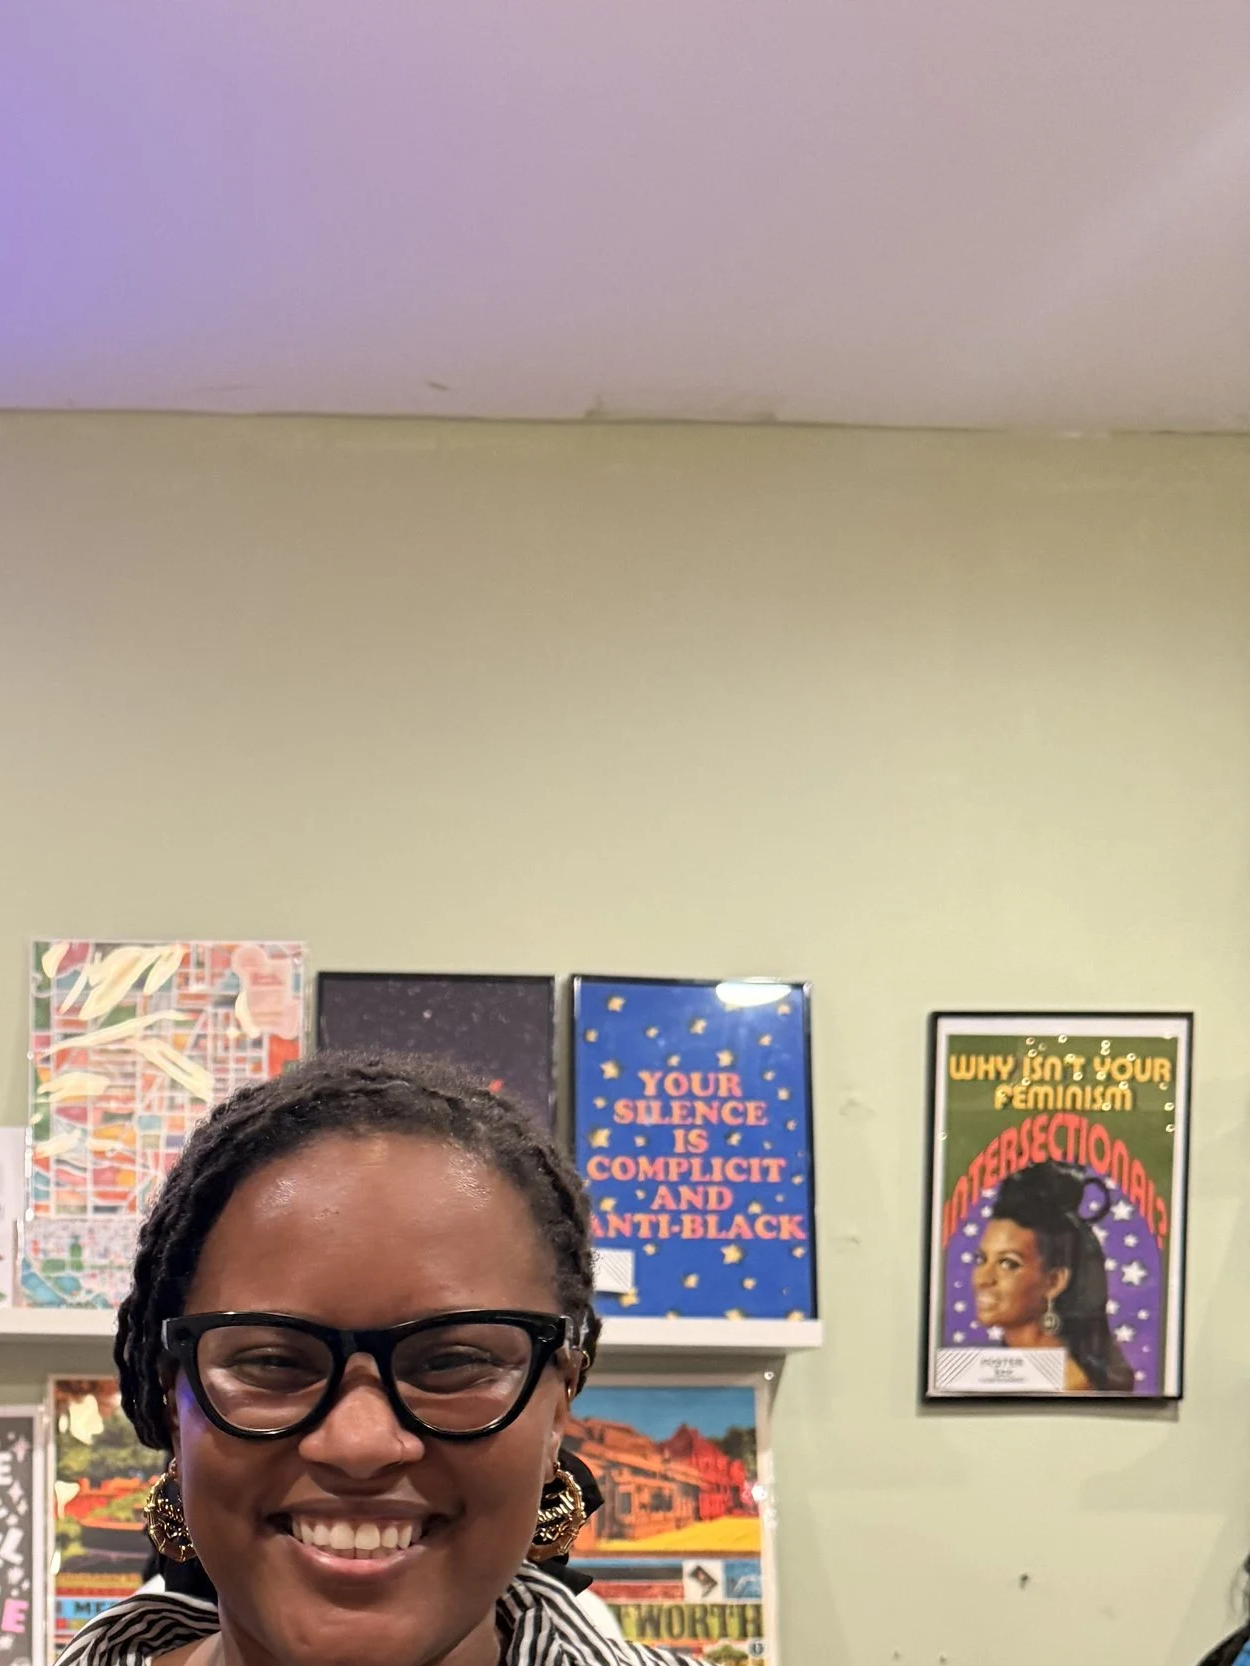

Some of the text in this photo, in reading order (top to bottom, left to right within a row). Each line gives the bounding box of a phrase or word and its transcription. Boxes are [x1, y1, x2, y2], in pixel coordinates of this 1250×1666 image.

[950, 1054, 1014, 1081] WHY
[1093, 1056, 1172, 1083] YOUR
[637, 1071, 743, 1098] YOUR
[994, 1084, 1133, 1111] FEMINISM
[612, 1101, 768, 1126] SILENCE
[672, 1128, 709, 1154] IS
[586, 1156, 786, 1183] COMPLICIT
[650, 1185, 734, 1211] AND
[636, 1603, 763, 1641] WORTH
